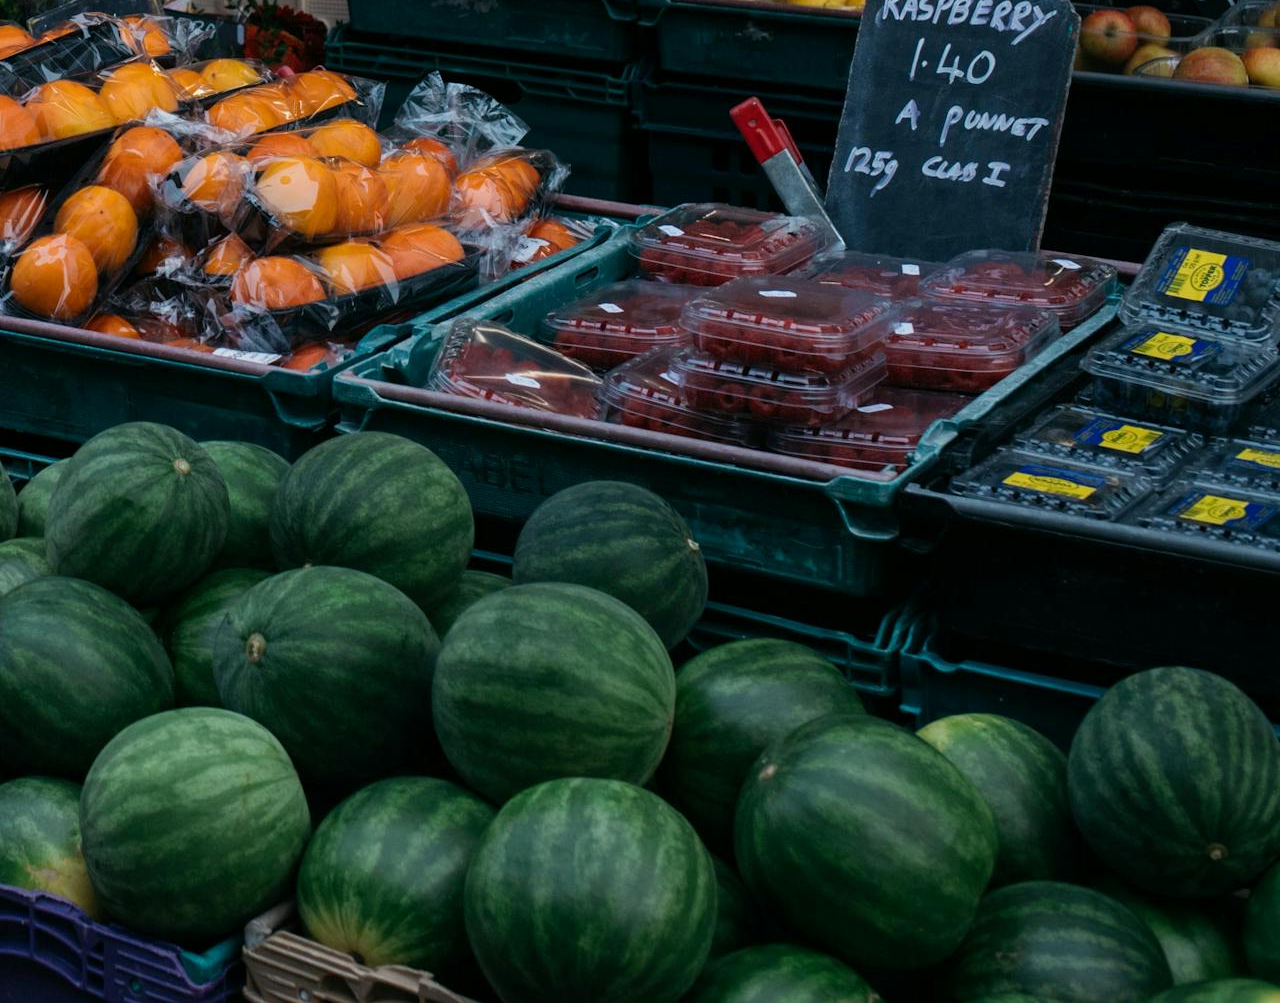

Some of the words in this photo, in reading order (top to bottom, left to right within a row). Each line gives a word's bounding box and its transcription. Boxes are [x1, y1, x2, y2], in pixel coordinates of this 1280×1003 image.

[894, 98, 921, 130] A
[940, 104, 1049, 148] PUNNET
[844, 146, 899, 198] 125g
